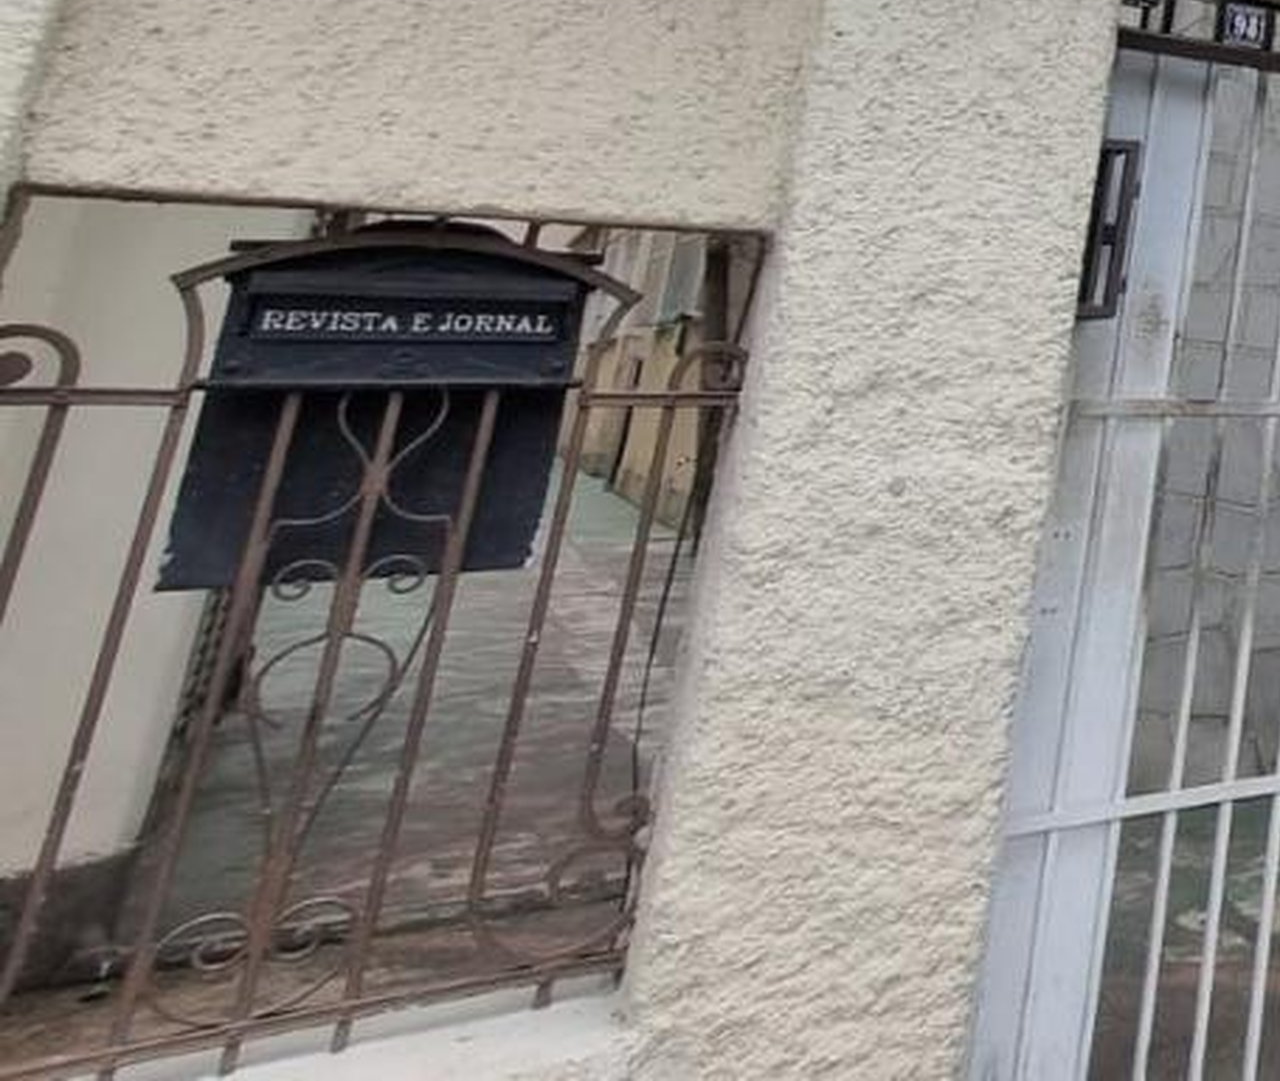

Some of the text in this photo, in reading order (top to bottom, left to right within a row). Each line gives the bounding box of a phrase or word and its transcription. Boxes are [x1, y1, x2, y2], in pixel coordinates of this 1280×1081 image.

[260, 309, 554, 334] REVISTA E JORNAL
